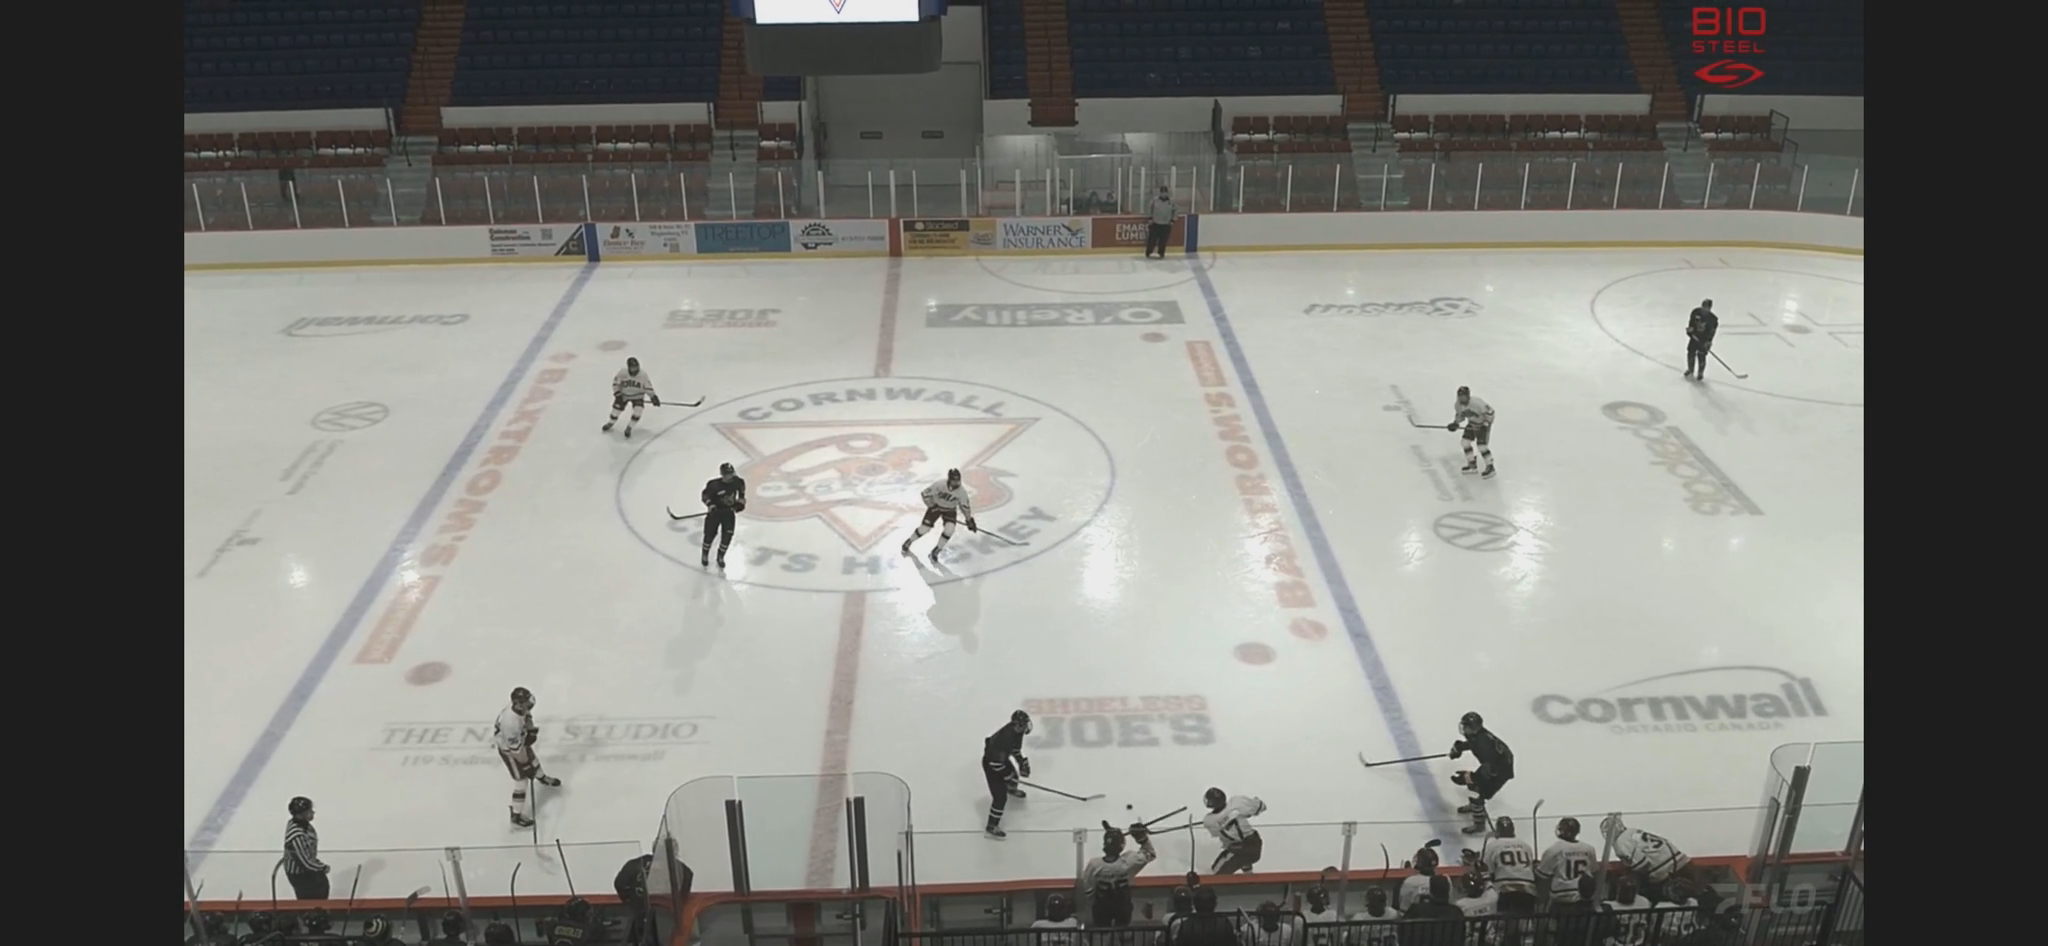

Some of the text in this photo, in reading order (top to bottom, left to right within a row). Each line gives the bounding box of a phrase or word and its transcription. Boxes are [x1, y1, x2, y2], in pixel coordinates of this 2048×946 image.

[703, 225, 785, 242] TREETOP
[1003, 223, 1062, 237] WARNER
[1003, 237, 1086, 249] INSURANCE
[282, 313, 470, 335] Cornwall
[951, 306, 1163, 325] O'Reilly
[738, 387, 1007, 421] CORNWALL
[418, 367, 569, 568] BAXTROM'S
[1022, 694, 1208, 716] SHOELESS
[1531, 677, 1828, 725] Cornwall
[382, 726, 449, 746] THE
[564, 721, 699, 743] STUDIO
[1024, 713, 1216, 750] JOE'S
[1611, 720, 1785, 735] ONTARIO CANADA
